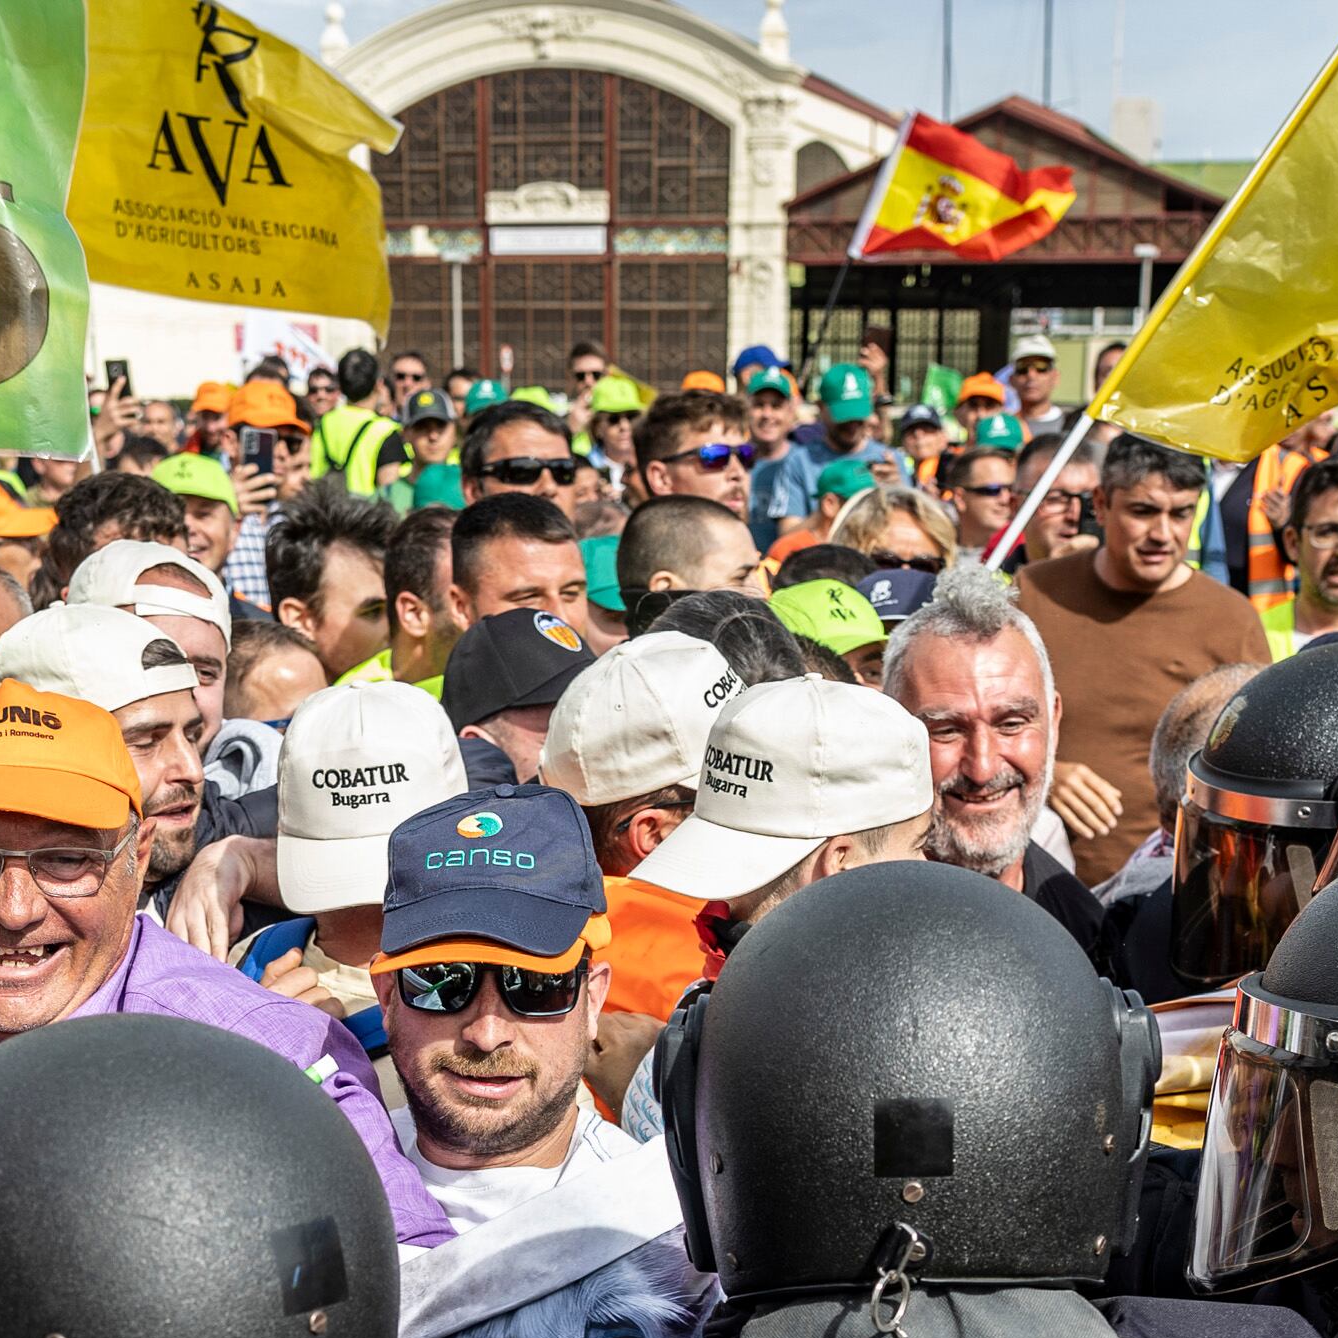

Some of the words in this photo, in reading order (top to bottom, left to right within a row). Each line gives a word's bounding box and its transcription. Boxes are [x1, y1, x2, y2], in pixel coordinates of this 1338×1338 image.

[147, 109, 293, 207] AVA
[115, 220, 262, 256] D'AGRICULTORS
[227, 214, 340, 249] VALENCIANA
[10, 729, 54, 740] Ramadera
[312, 763, 409, 789] COBATUR
[705, 769, 748, 799] Bugarra
[332, 792, 390, 809] Bugarra
[426, 848, 536, 870] canso
